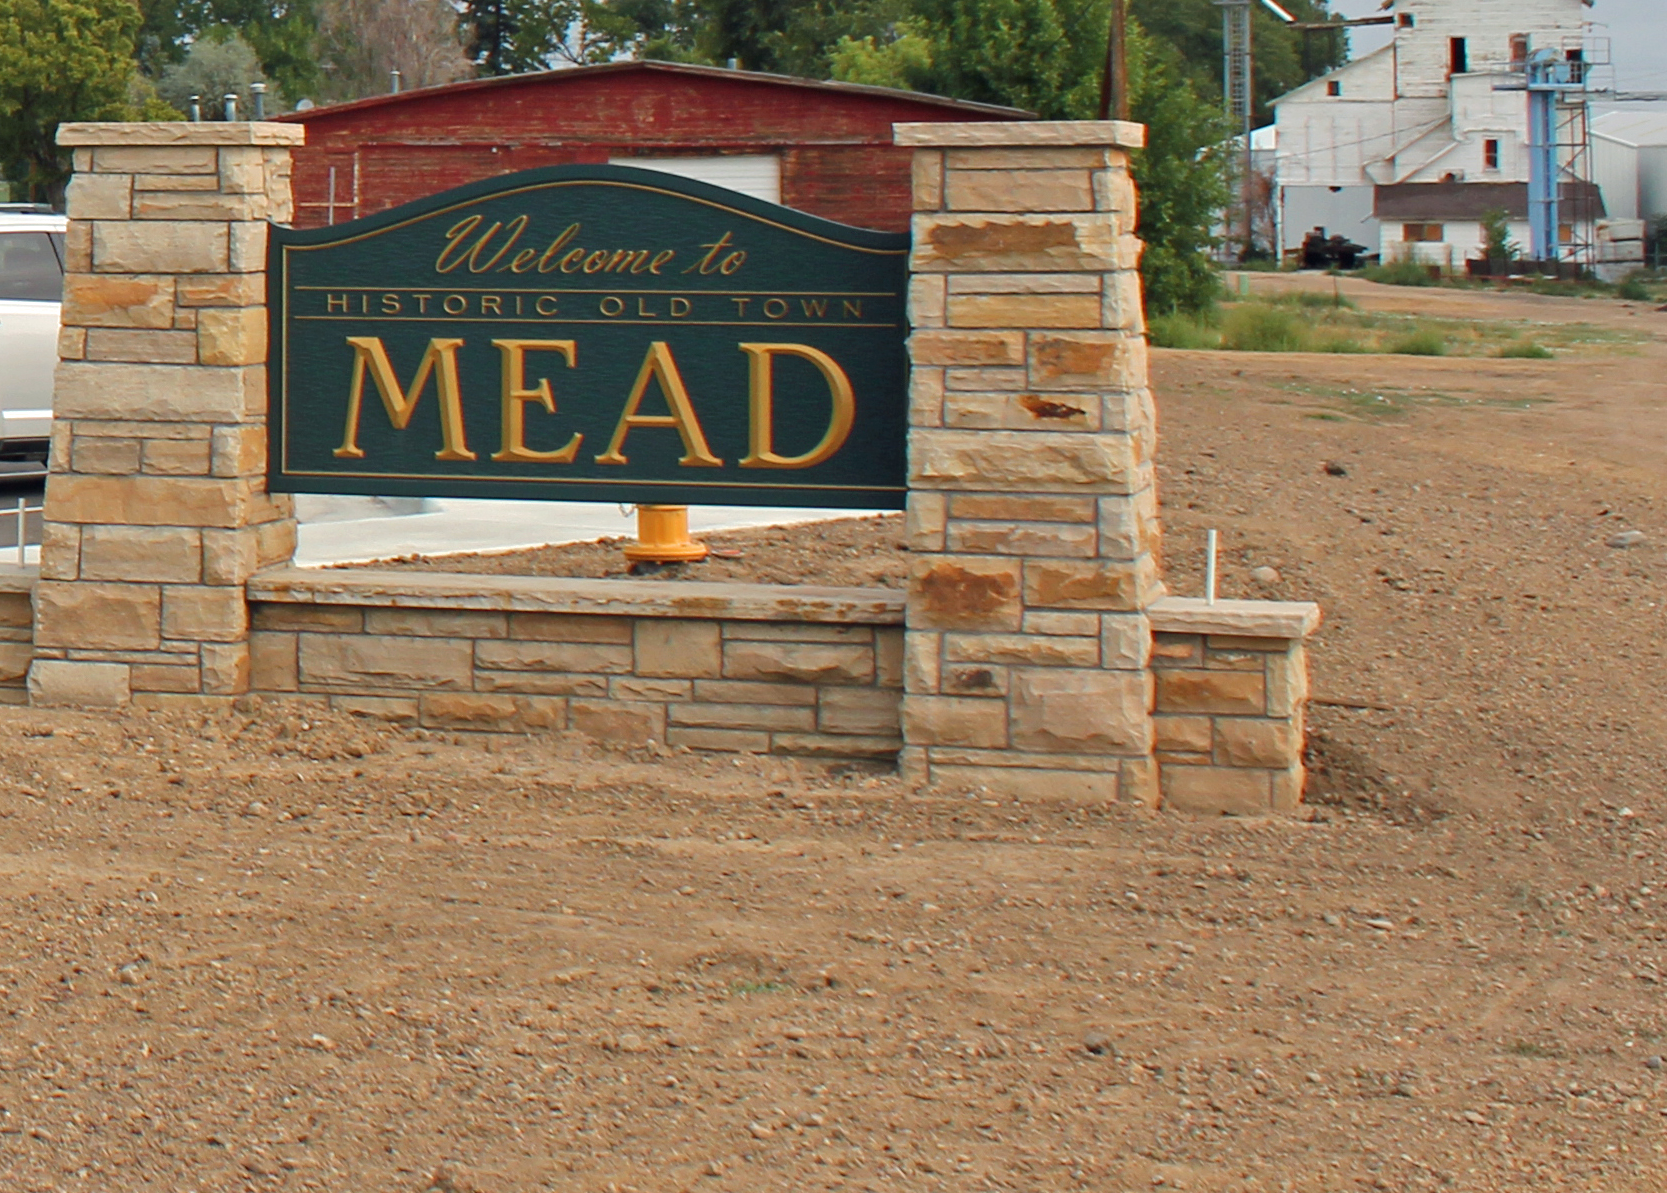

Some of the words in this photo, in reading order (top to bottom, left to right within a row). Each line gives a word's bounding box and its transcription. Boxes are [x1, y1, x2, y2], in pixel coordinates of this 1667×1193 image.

[435, 215, 676, 275] Welcome
[681, 231, 748, 276] to
[326, 294, 559, 316] HISTORIC
[599, 296, 693, 319] OLD
[731, 298, 863, 320] TOWN
[332, 336, 856, 469] MEAD
